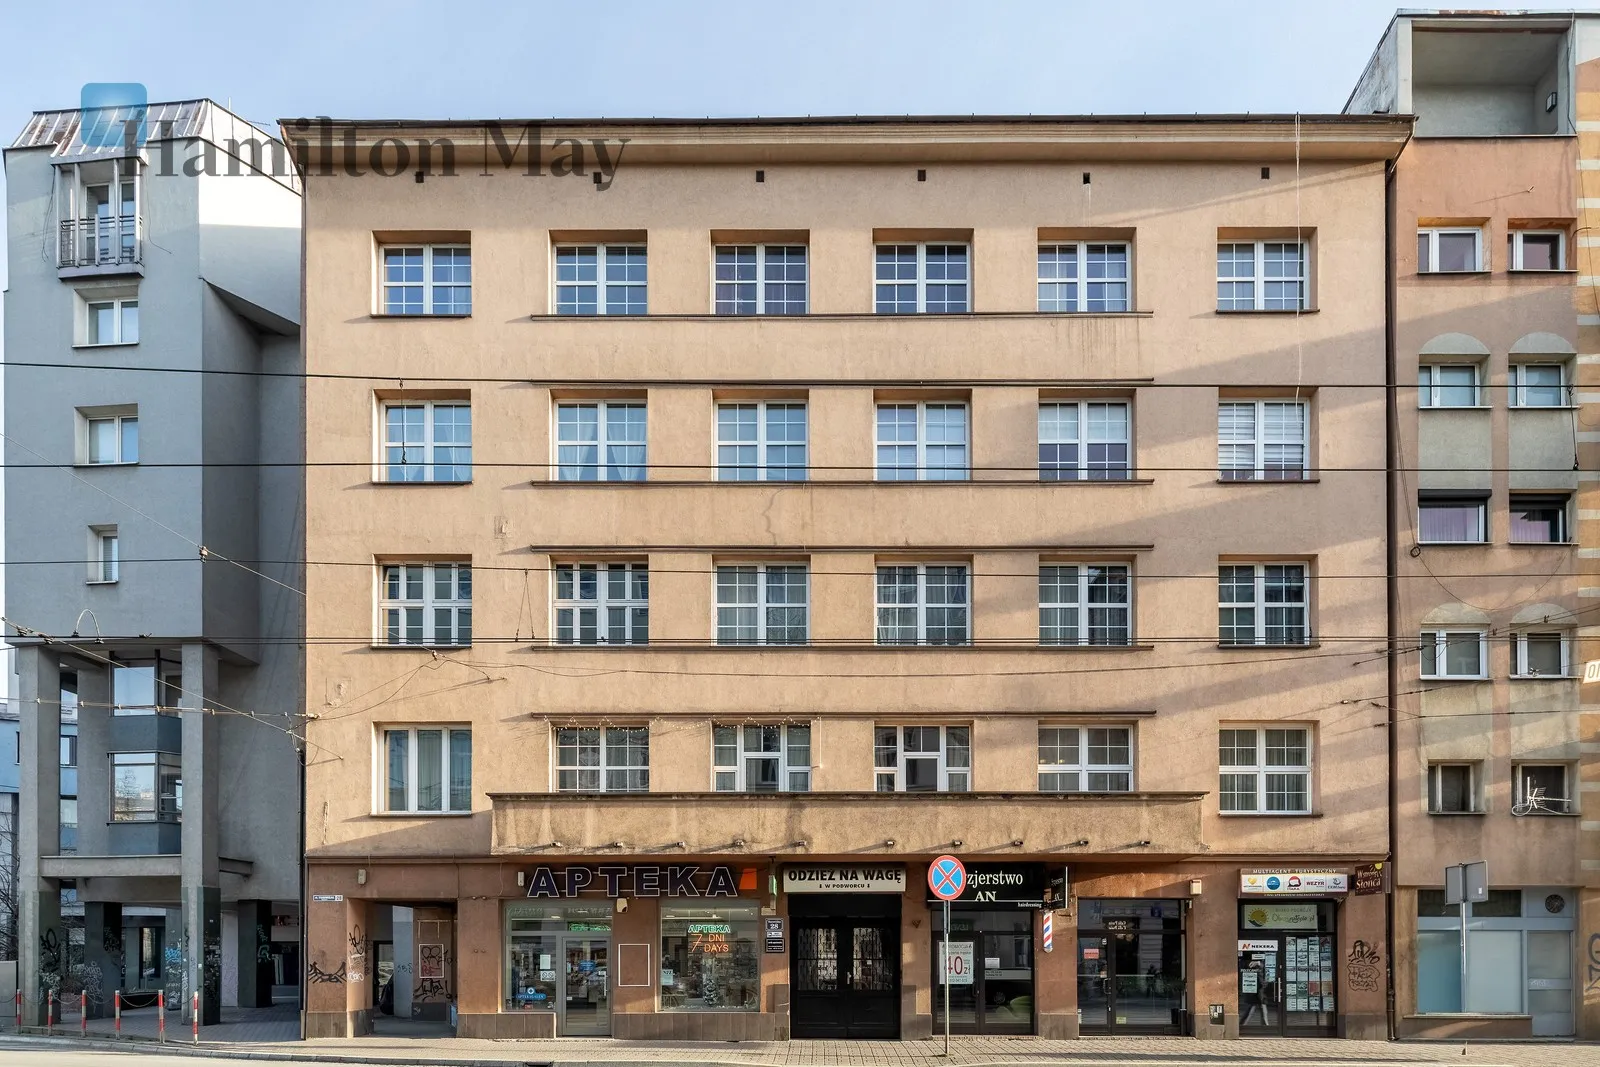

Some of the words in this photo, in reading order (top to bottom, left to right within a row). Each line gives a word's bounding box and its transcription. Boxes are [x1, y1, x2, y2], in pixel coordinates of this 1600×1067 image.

[526, 866, 739, 898] APTEKA
[839, 869, 859, 881] NA
[862, 869, 902, 884] WAGĘ
[965, 870, 1024, 889] zjerstwo
[974, 891, 997, 902] AN
[687, 924, 731, 934] APTEKA
[690, 933, 703, 953] 7
[708, 933, 725, 942] DNI
[704, 943, 729, 953] DAYS
